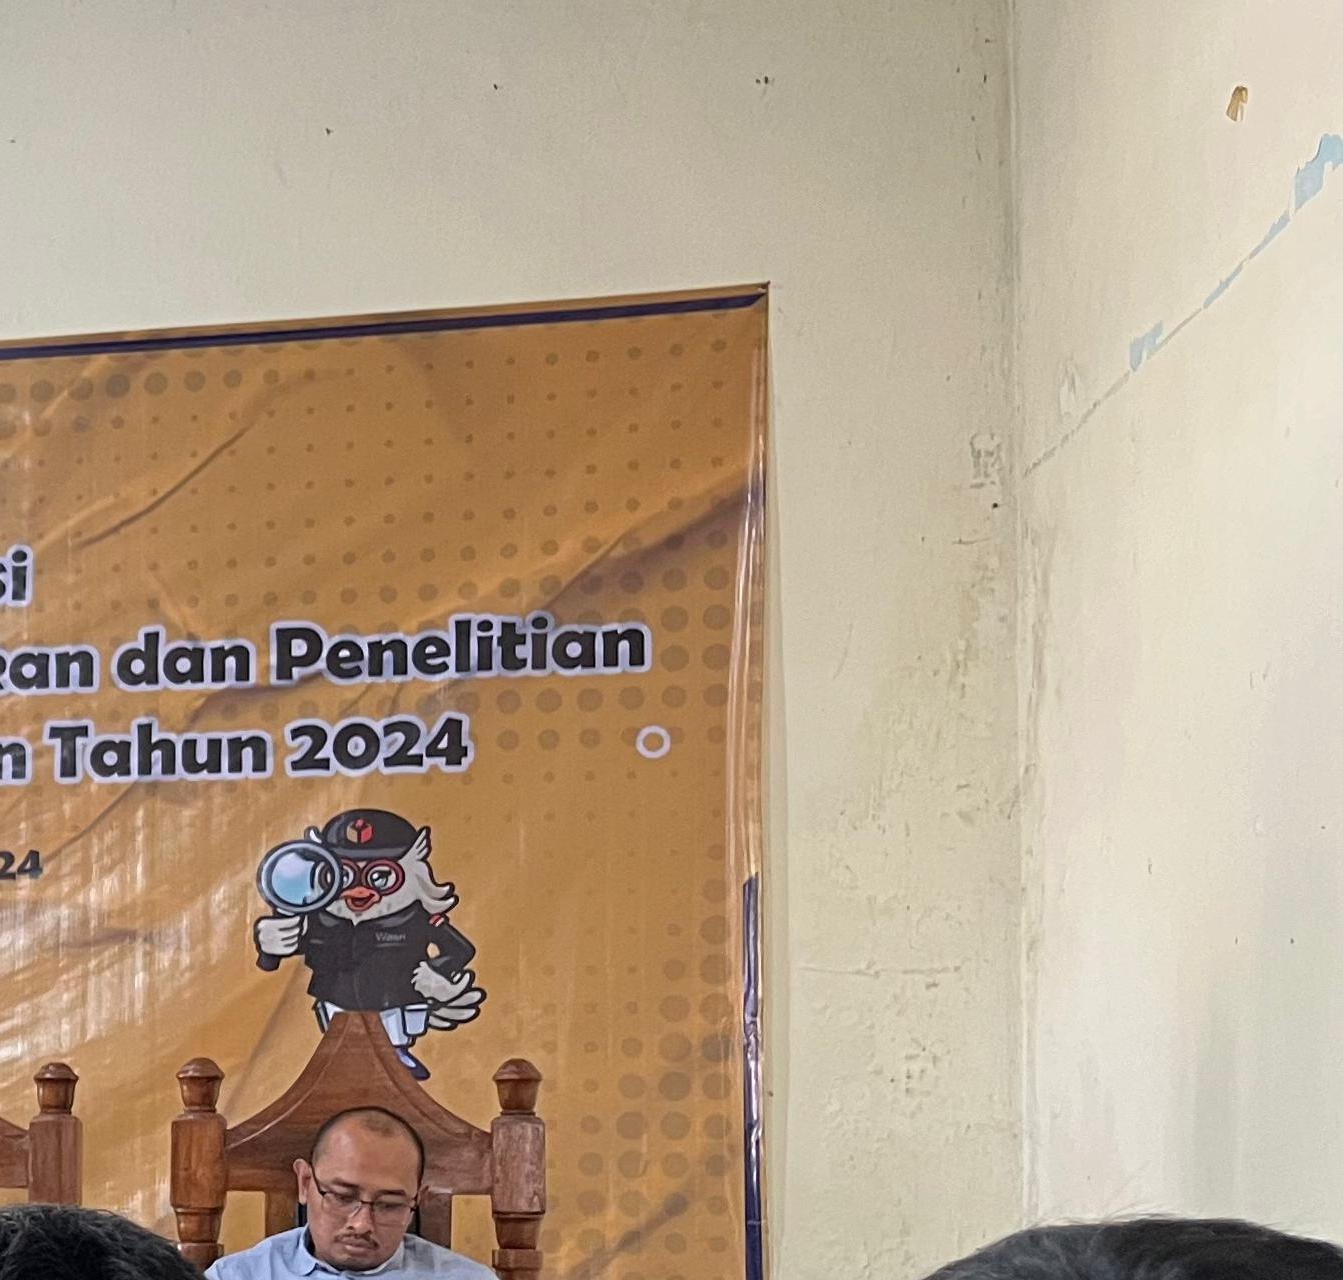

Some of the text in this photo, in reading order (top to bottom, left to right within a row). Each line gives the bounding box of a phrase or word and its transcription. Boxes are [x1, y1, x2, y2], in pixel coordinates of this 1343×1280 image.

[118, 631, 250, 688] dan
[276, 619, 646, 680] Penelitian
[50, 723, 267, 778] Tahun
[290, 719, 467, 768] 2024
